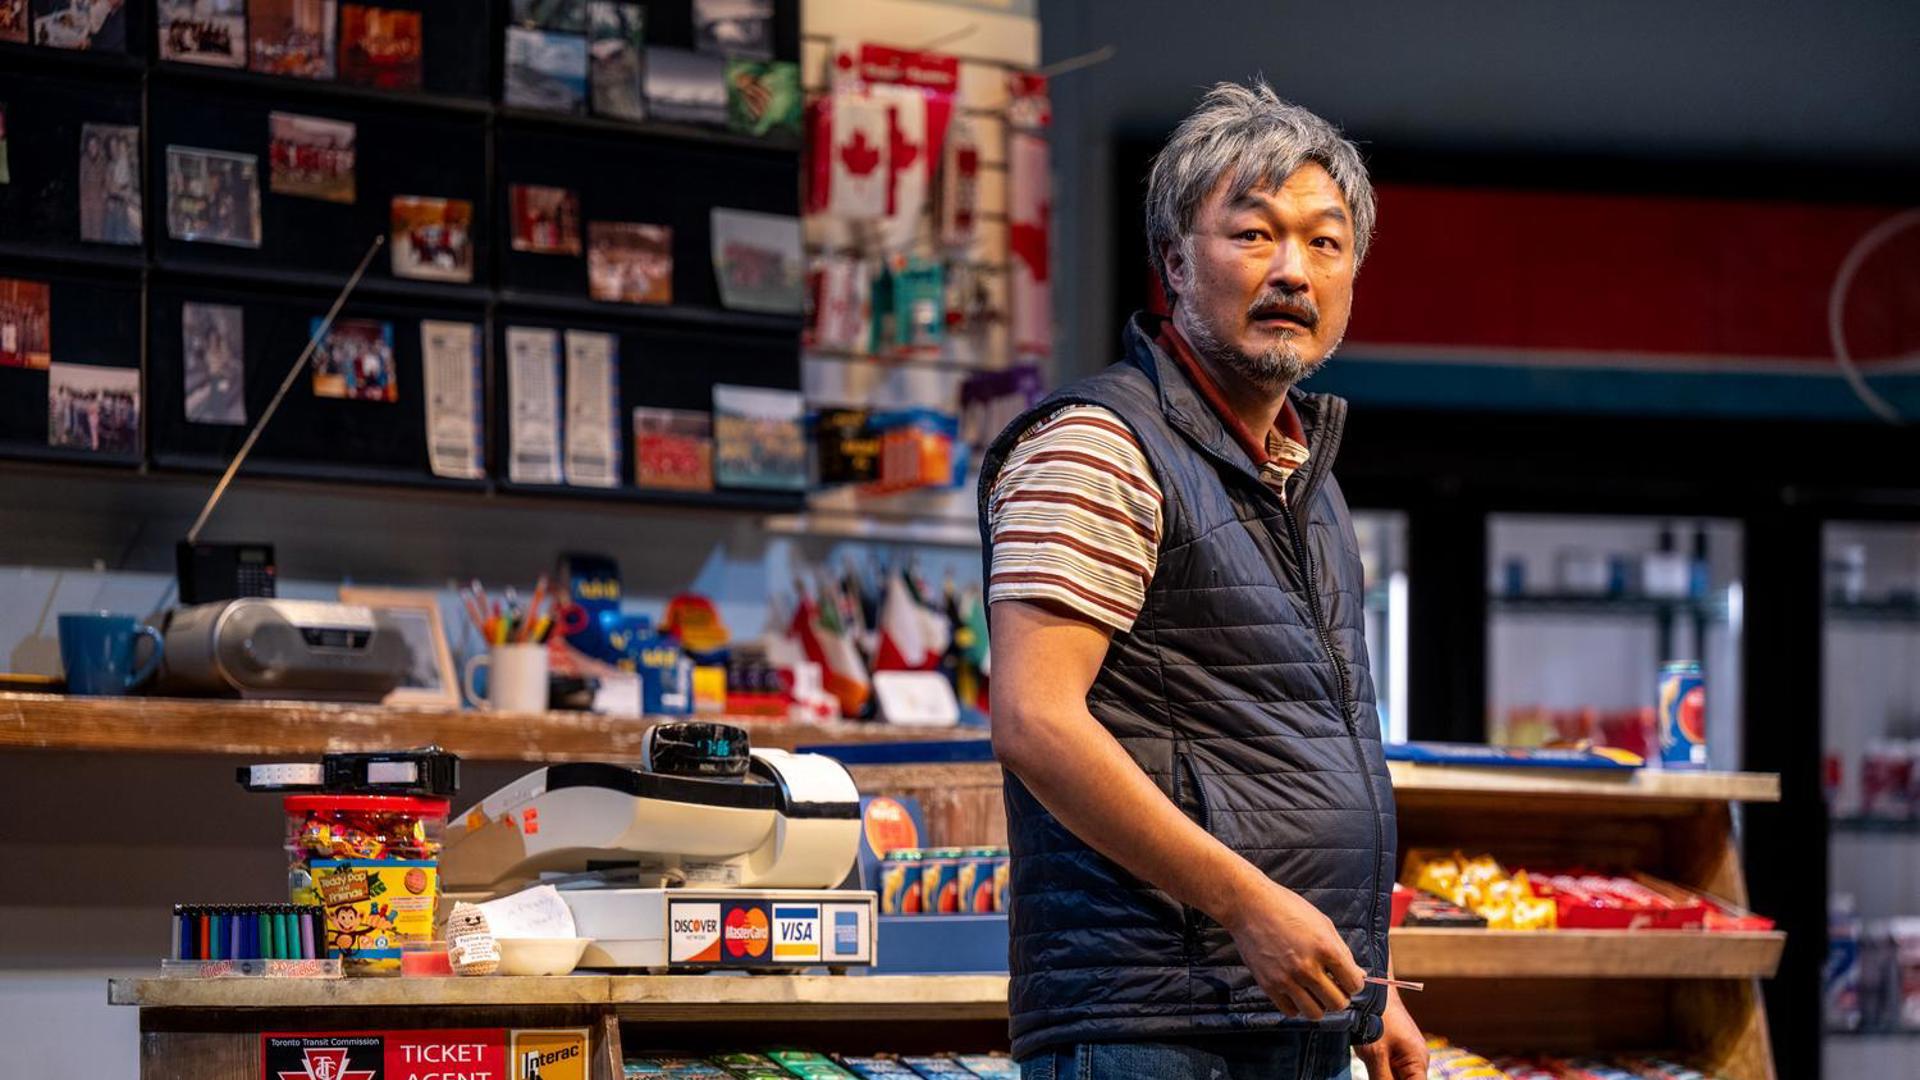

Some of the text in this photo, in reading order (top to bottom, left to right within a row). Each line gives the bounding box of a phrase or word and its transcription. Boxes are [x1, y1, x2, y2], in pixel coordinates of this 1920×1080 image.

[320, 872, 367, 889] Teddy Pop
[674, 919, 717, 933] DISCOVER
[725, 925, 769, 940] MasterCard
[781, 921, 813, 941] VISA
[271, 1038, 379, 1047] Toronto Transit Commission
[400, 1044, 488, 1062] TICKET
[522, 1044, 579, 1079] Interac
